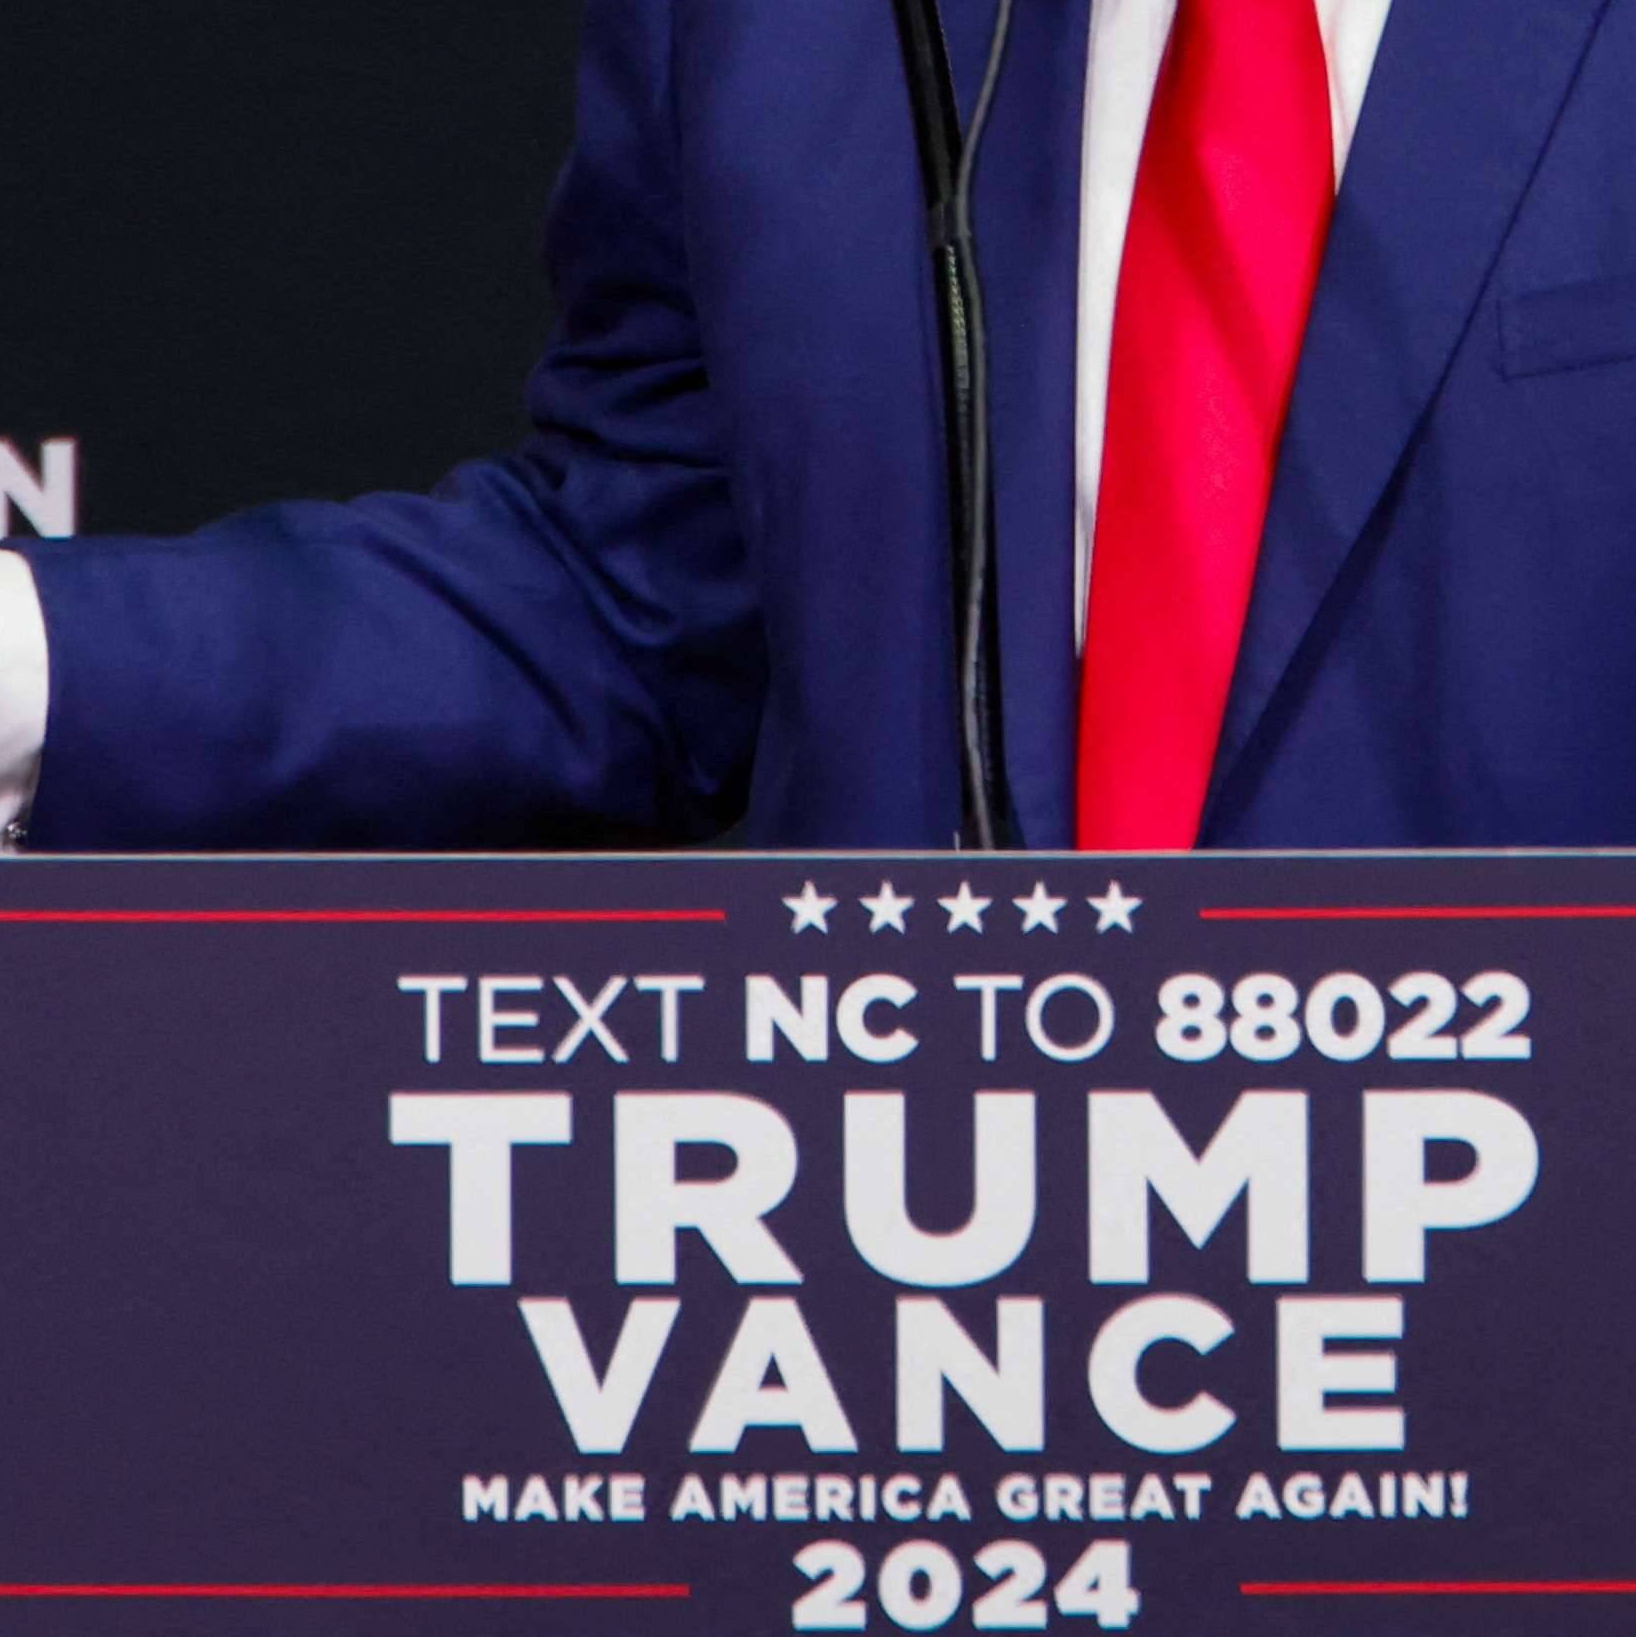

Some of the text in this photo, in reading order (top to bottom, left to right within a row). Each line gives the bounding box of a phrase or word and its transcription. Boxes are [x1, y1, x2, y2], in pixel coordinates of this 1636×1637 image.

[395, 969, 1534, 1065] TEXT NC TO 88022
[386, 1087, 1541, 1288] TRUMP
[516, 1292, 1407, 1455] VANCE
[460, 1470, 1470, 1523] MAKE AMERICA GREAT AGAIN!
[790, 1538, 1142, 1631] 2024
